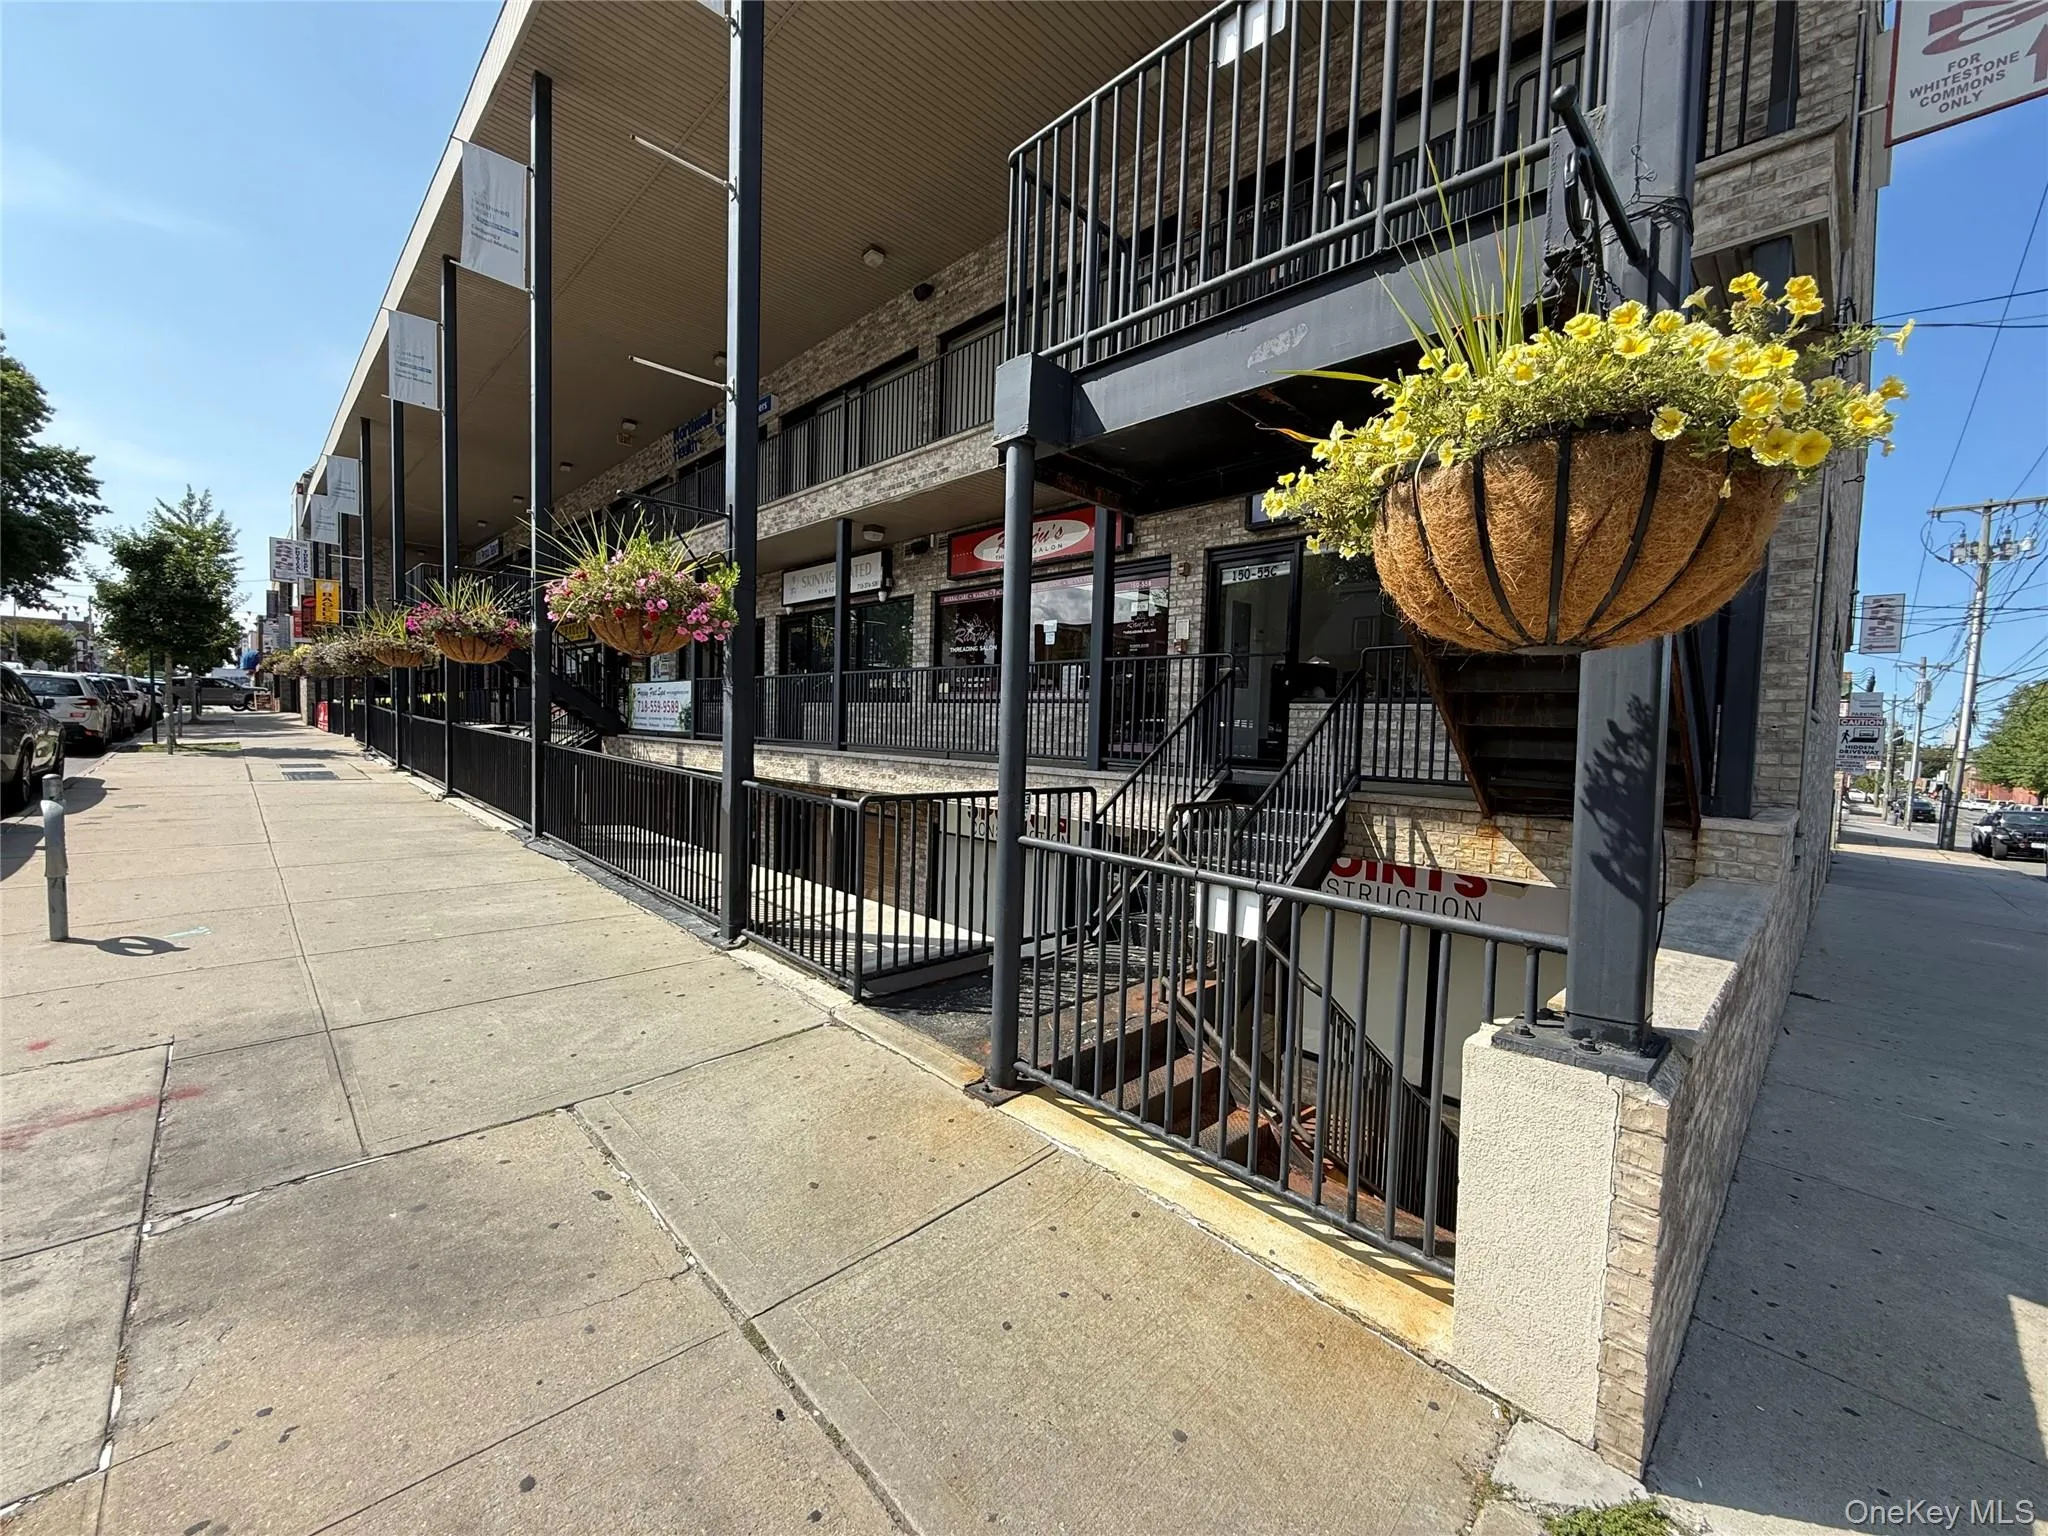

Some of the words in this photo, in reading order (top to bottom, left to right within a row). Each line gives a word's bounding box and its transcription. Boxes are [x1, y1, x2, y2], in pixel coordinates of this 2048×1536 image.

[1947, 52, 1981, 73] FOR
[1909, 50, 2020, 99] WHITESTONE
[1919, 69, 2006, 108] COMMONS
[1938, 90, 1983, 114] ONLY
[1032, 543, 1063, 553] SALON
[1232, 566, 1279, 581] 150-55C
[950, 645, 978, 653] THREADING
[637, 700, 679, 713] 718-559-9589
[1330, 857, 1488, 898] OINTS
[1326, 878, 1482, 922] STRUCTION
